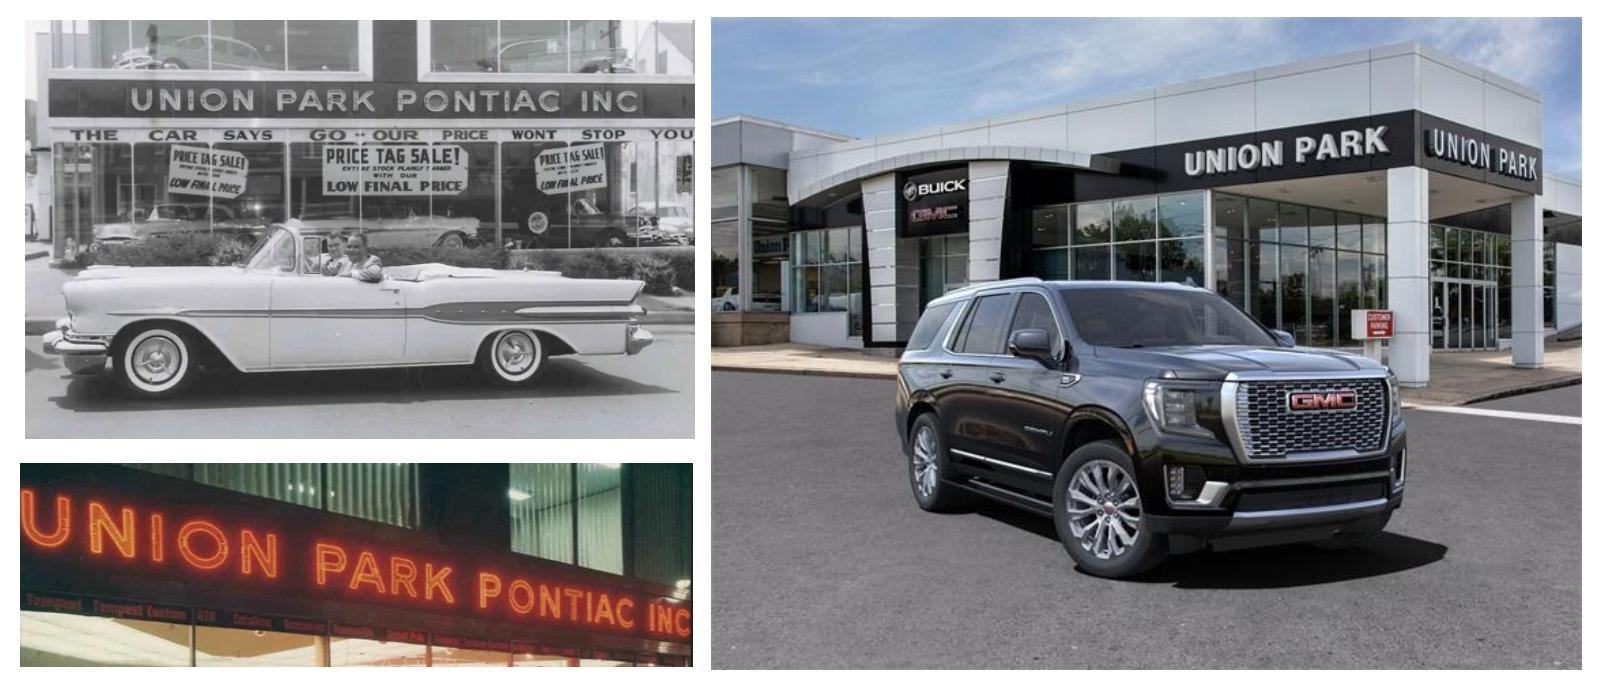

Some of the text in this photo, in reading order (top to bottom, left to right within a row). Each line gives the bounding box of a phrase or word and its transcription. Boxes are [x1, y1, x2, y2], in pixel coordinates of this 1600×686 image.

[131, 88, 639, 112] UNION PARK PONTIAC INC
[70, 129, 694, 141] THE CAR SAYS GO OUR PRICE WONT STOP YOU
[174, 149, 199, 164] PRICE
[201, 152, 217, 166] TAG
[326, 147, 460, 165] PRICE TAG SALE!
[540, 153, 561, 166] PRICE
[564, 150, 580, 163] TAG
[1184, 125, 1390, 176] UNION PARK
[1433, 127, 1538, 181] UNION PARK
[170, 177, 242, 194] LOW FINAL PRICE
[327, 181, 462, 192] LOW FINAL PRICE
[541, 181, 557, 190] LOW
[581, 174, 604, 185] PRICE
[918, 179, 966, 195] BUICK
[911, 205, 958, 222] GMC
[1291, 393, 1355, 410] GMC
[21, 487, 690, 638] UNION PARK PONTIAC INC
